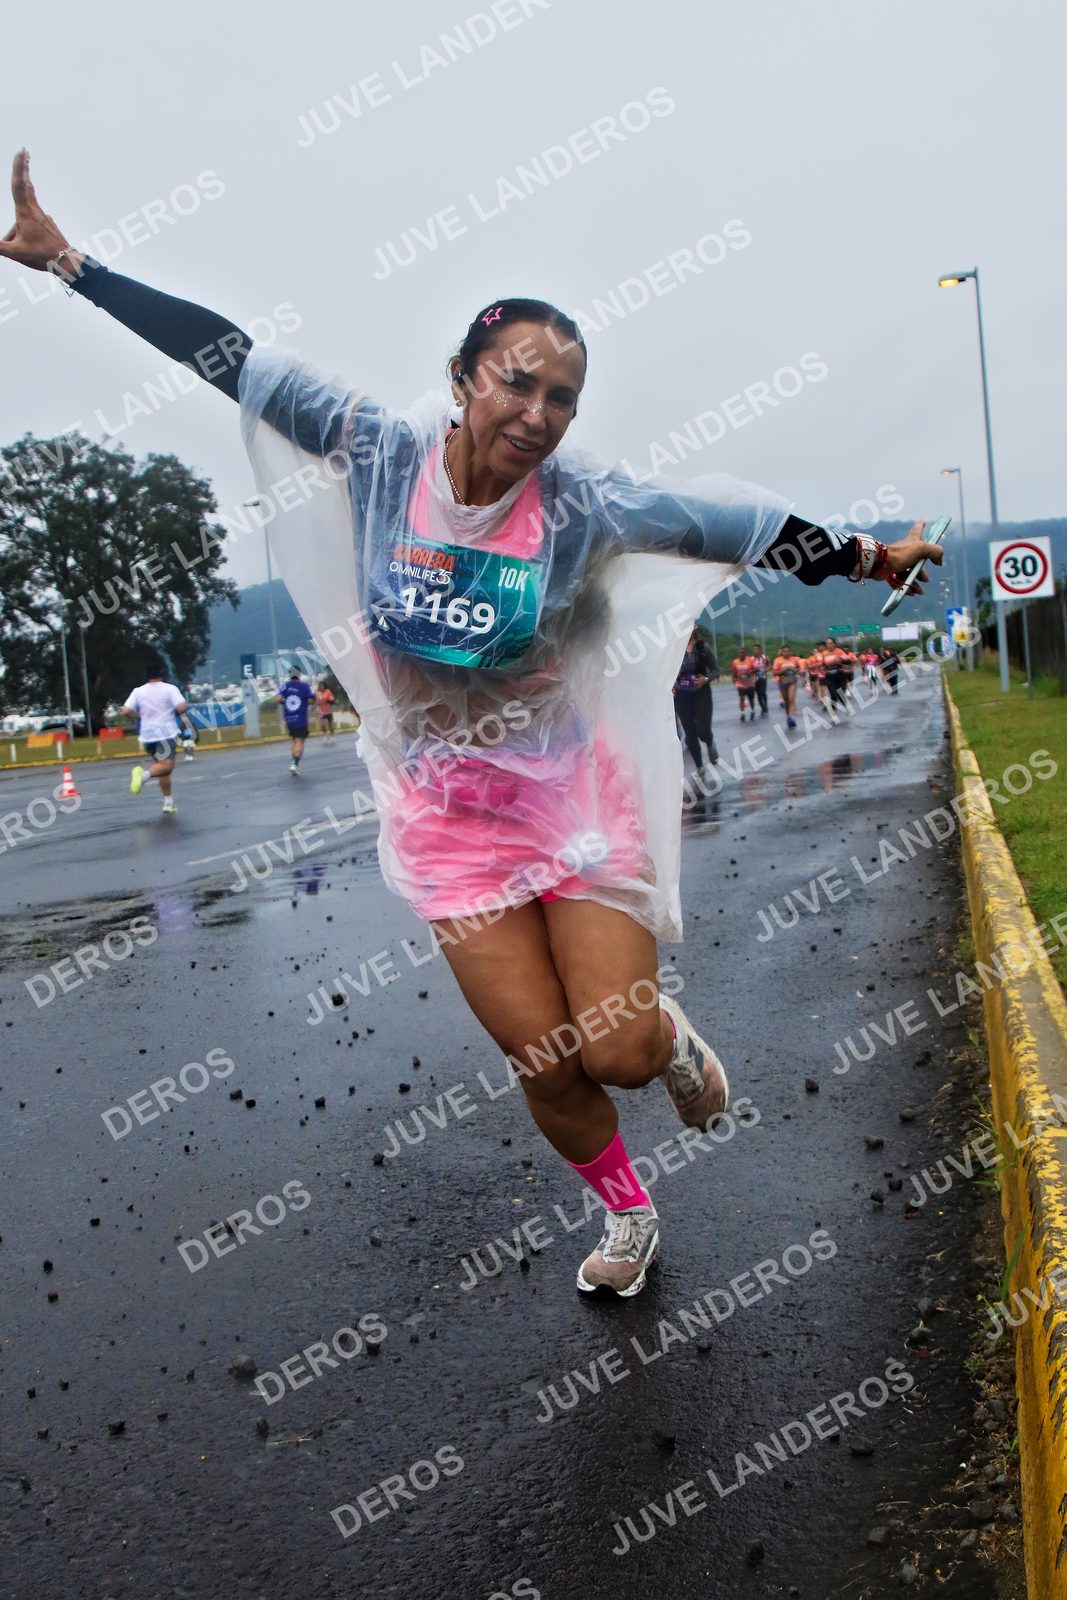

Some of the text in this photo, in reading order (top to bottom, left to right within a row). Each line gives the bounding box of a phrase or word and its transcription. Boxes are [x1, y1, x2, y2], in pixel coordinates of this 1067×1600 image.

[1004, 555, 1038, 578] 30
[498, 566, 531, 592] 10K
[401, 587, 496, 634] 1169
[243, 664, 253, 676] E
